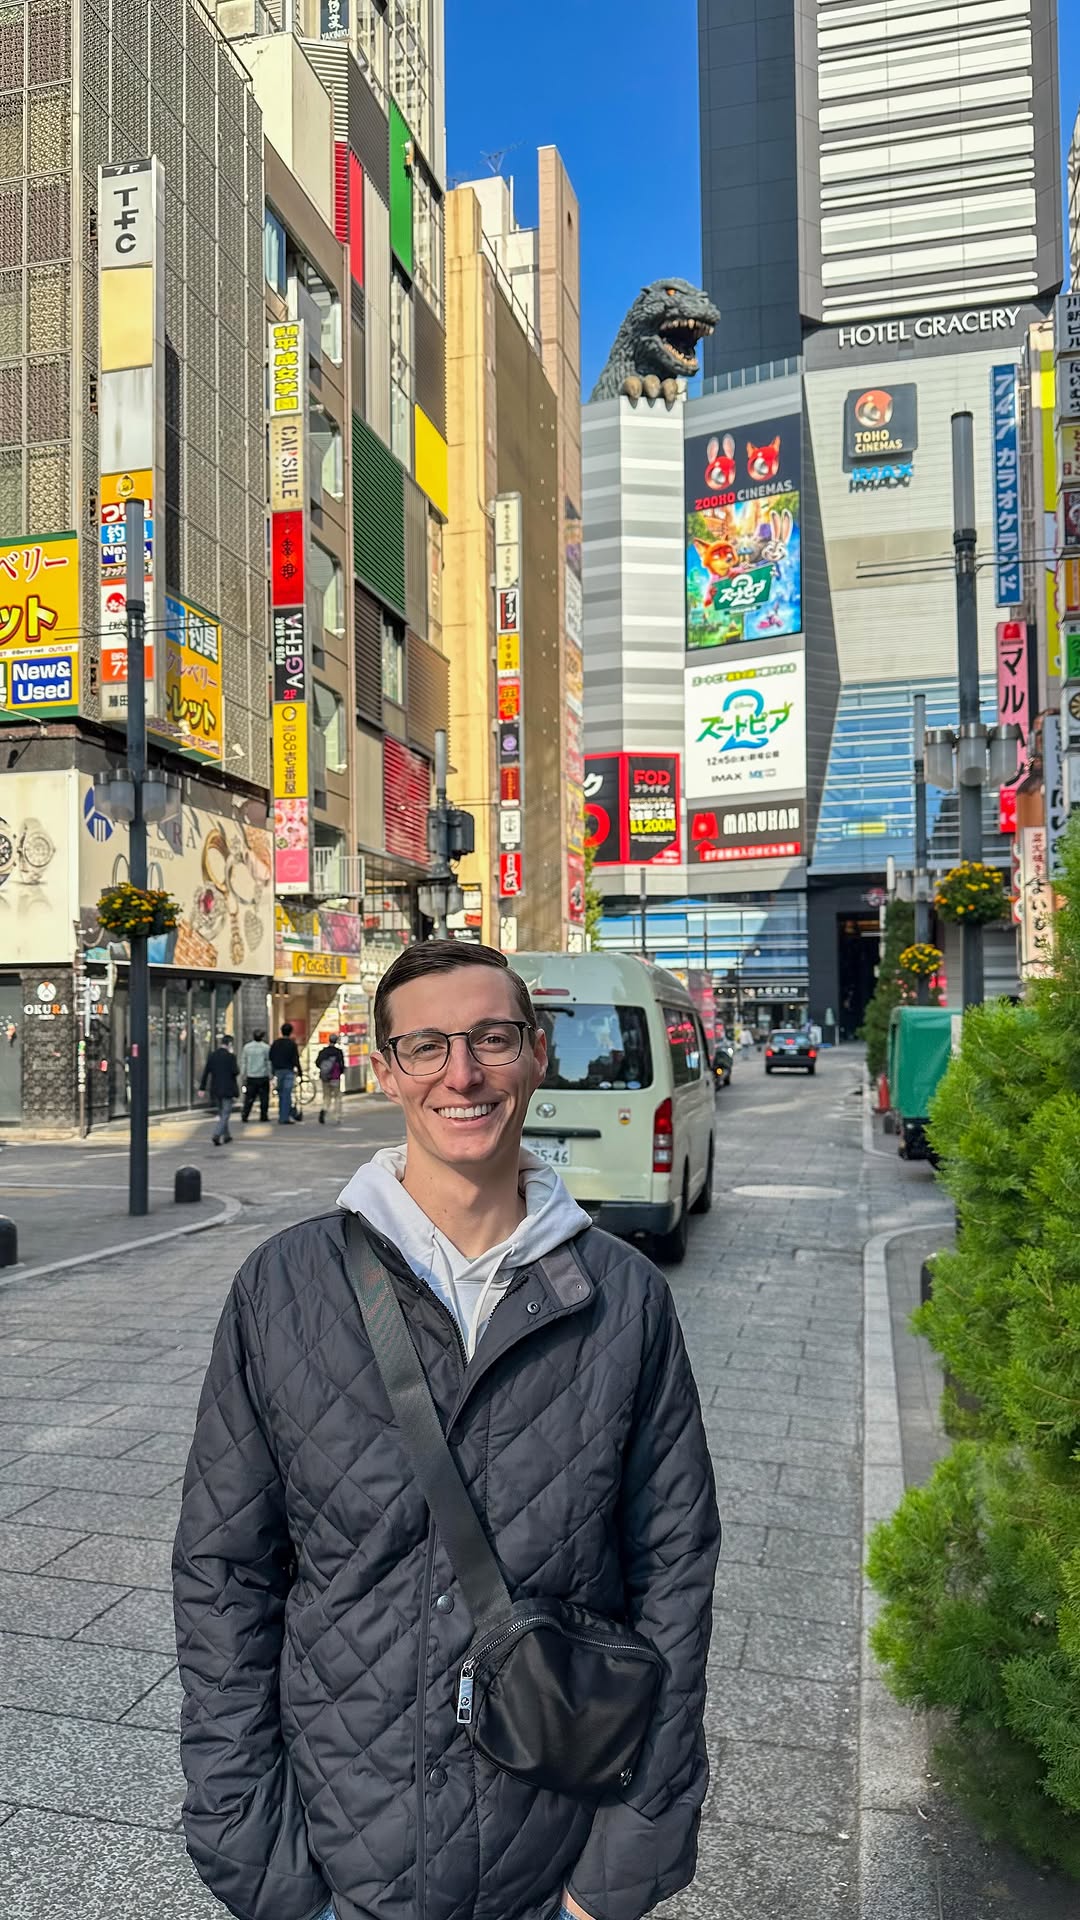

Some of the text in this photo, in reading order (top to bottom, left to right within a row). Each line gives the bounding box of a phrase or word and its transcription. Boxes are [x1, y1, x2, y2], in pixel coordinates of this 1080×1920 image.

[113, 187, 139, 254] TFC
[838, 306, 1021, 347] HOTEL GRACERY
[855, 430, 890, 443] TOHO
[855, 439, 903, 453] CINEMAS
[281, 425, 299, 499] CAPSULE
[852, 463, 914, 480] IMAX
[737, 479, 793, 501] CINEMAS
[995, 374, 1018, 596] 747 カラオケランド
[102, 546, 127, 558] Ne
[285, 613, 304, 689] AGEHA
[17, 680, 70, 701] Used
[696, 701, 794, 742] ズートピア
[634, 769, 671, 785] FOD
[711, 773, 742, 783] IMAX
[723, 808, 799, 834] MARUHAN
[24, 1004, 69, 1015] OKURA
